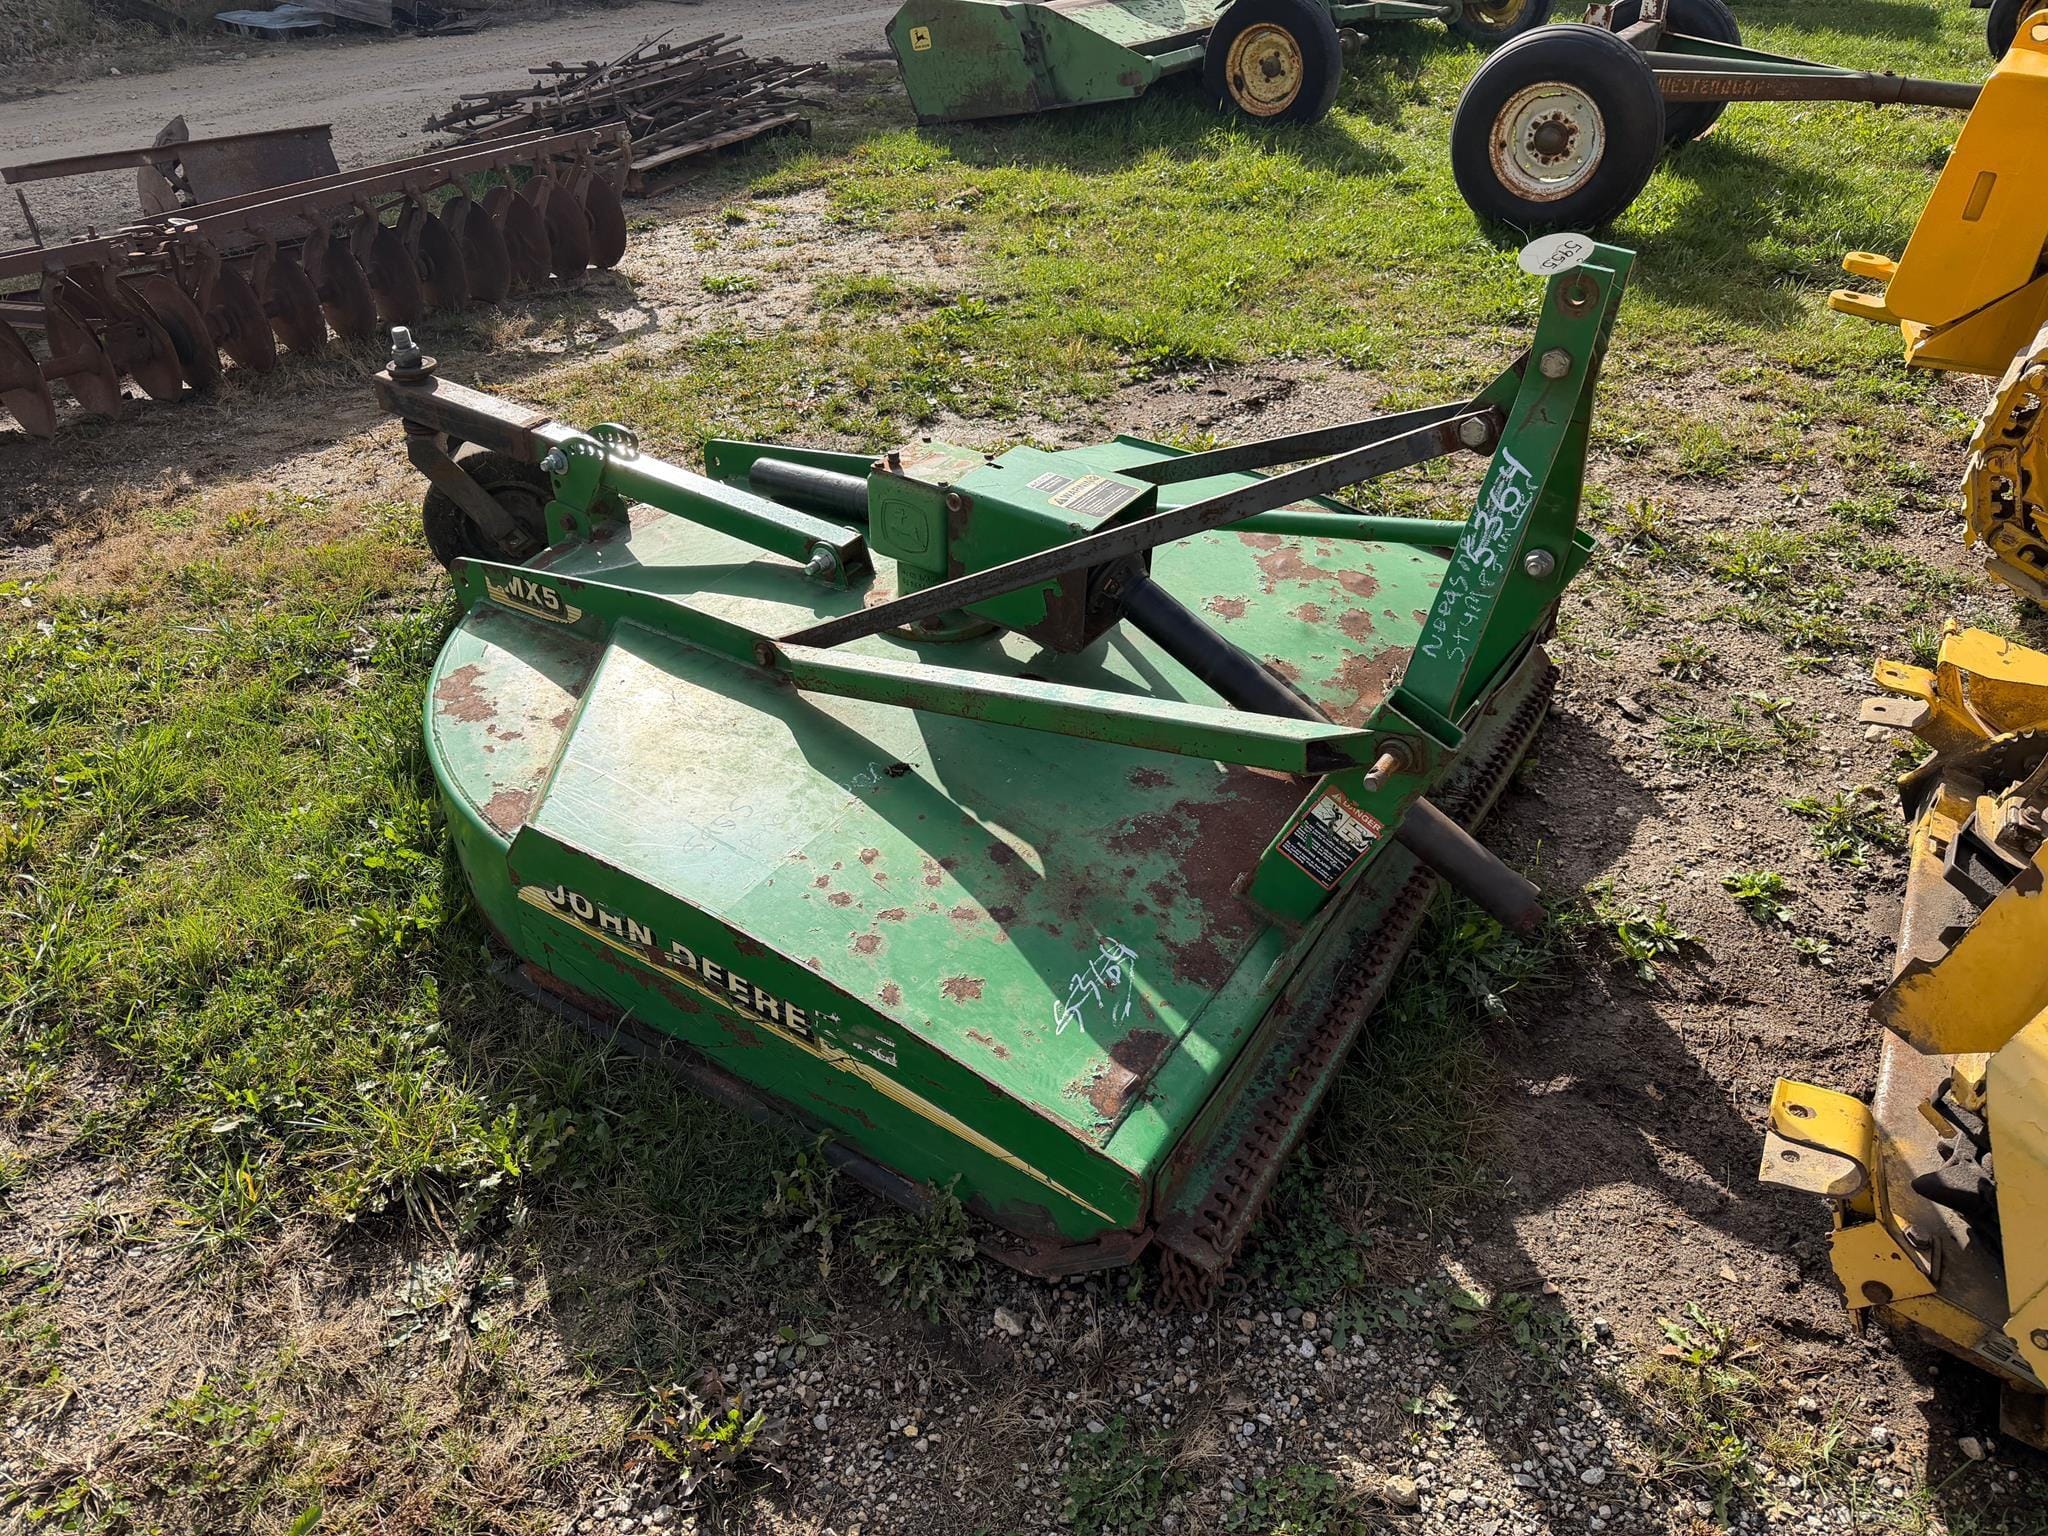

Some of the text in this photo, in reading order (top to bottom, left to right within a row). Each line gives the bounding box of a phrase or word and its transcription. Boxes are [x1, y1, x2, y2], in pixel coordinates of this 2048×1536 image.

[1540, 239, 1584, 269] 5955
[1466, 447, 1533, 567] 5364
[505, 576, 560, 610] MX5
[1342, 800, 1382, 832] DANGER
[546, 884, 809, 1036] JOHN DEERE
